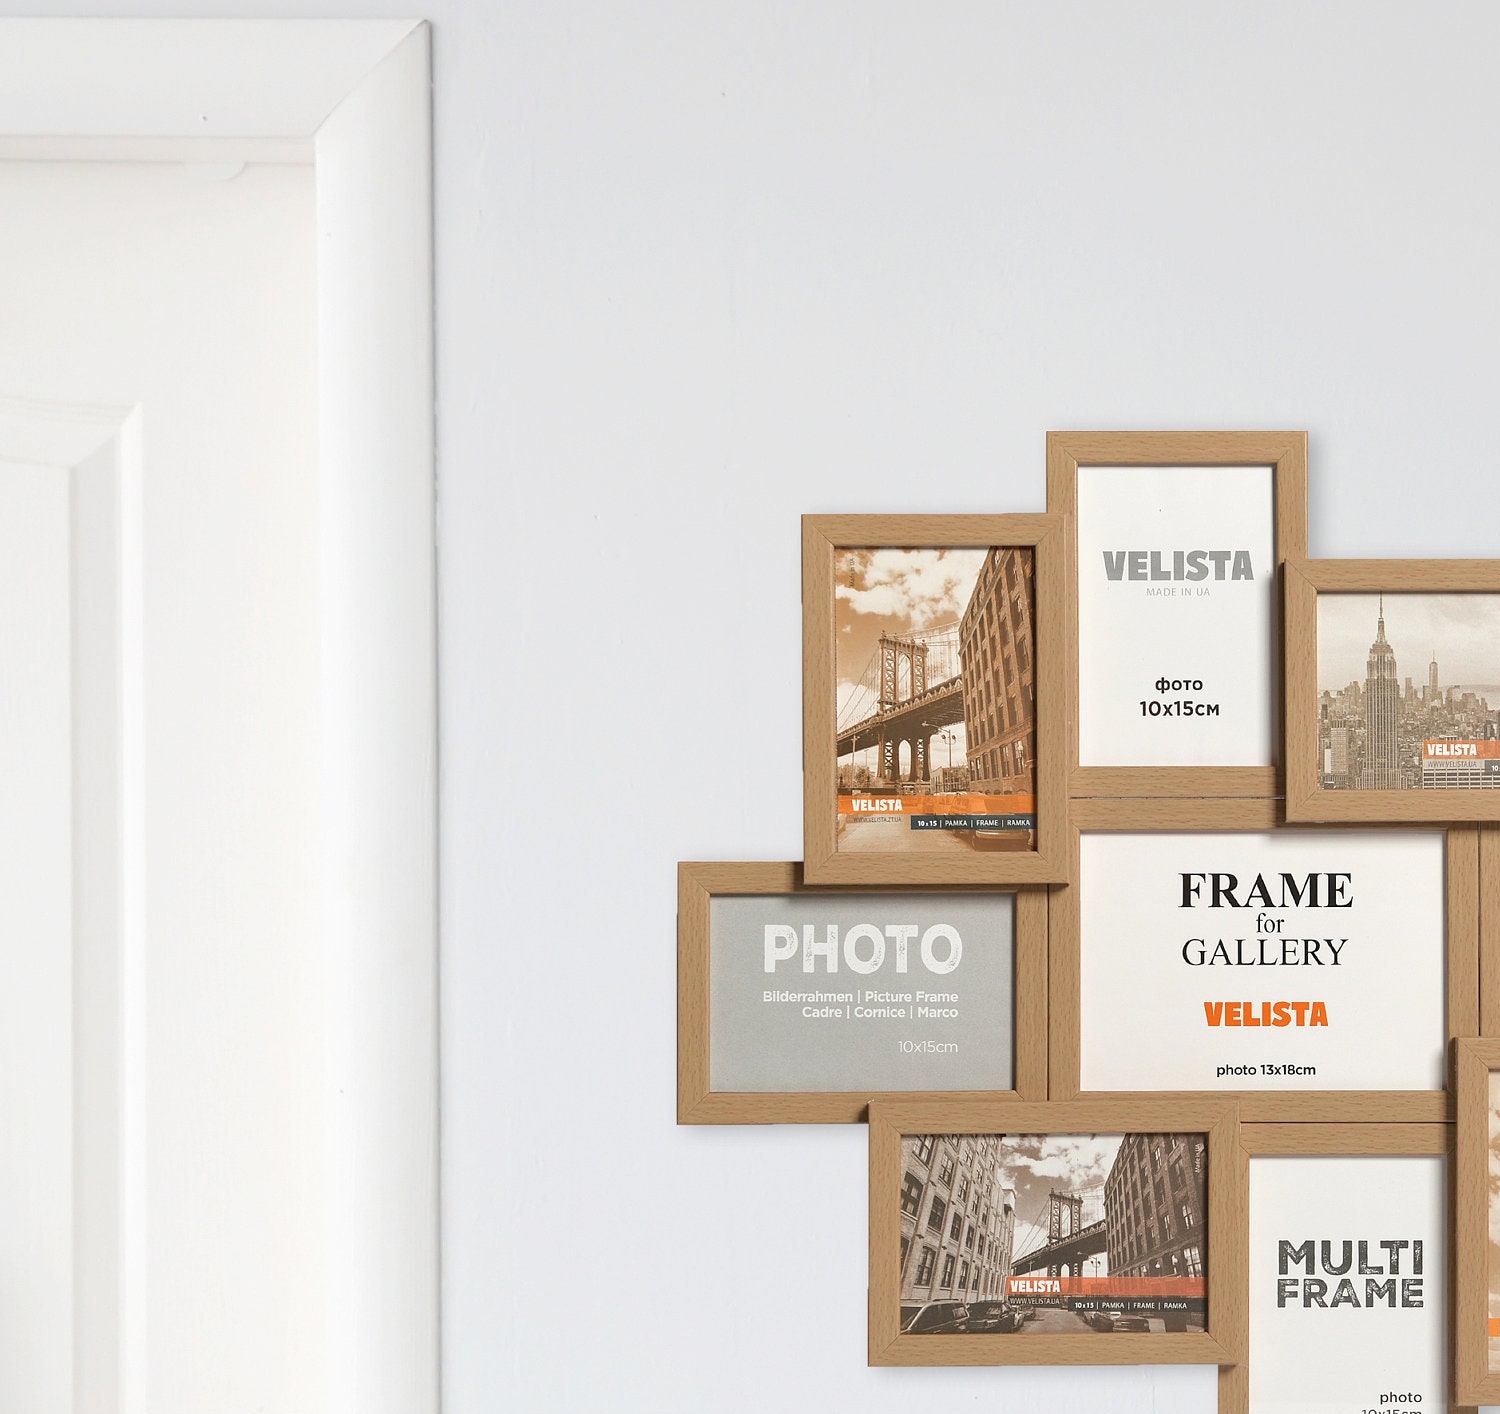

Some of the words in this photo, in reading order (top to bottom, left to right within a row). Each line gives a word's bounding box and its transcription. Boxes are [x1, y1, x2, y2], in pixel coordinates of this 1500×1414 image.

[1103, 550, 1254, 581] VELISTA
[1146, 587, 1177, 597] MADE
[1181, 587, 1191, 597] IN
[1197, 587, 1210, 597] UA
[1155, 677, 1203, 693] фото
[1427, 743, 1477, 756] VELISTA
[852, 799, 903, 811] VELISTA
[1178, 872, 1353, 908] FRAME
[1256, 912, 1285, 934] for
[764, 923, 963, 975] PHOTO
[1182, 938, 1349, 966] GALLERY
[763, 990, 853, 1003] Bilderrahmen
[865, 990, 912, 1003] Picture
[916, 990, 959, 1003] Frame
[802, 1005, 842, 1018] Cadre
[854, 1005, 905, 1018] Cornice
[917, 1005, 959, 1018] Marco
[1203, 1001, 1329, 1028] VELISTA
[898, 1040, 958, 1053] 10x15cm
[1216, 1063, 1257, 1078] photo
[1260, 1063, 1316, 1076] 13x18cm
[1278, 1240, 1423, 1275] MULTI
[1010, 1280, 1061, 1293] VELISTA
[1277, 1279, 1424, 1308] FRAME
[1379, 1391, 1423, 1406] photo
